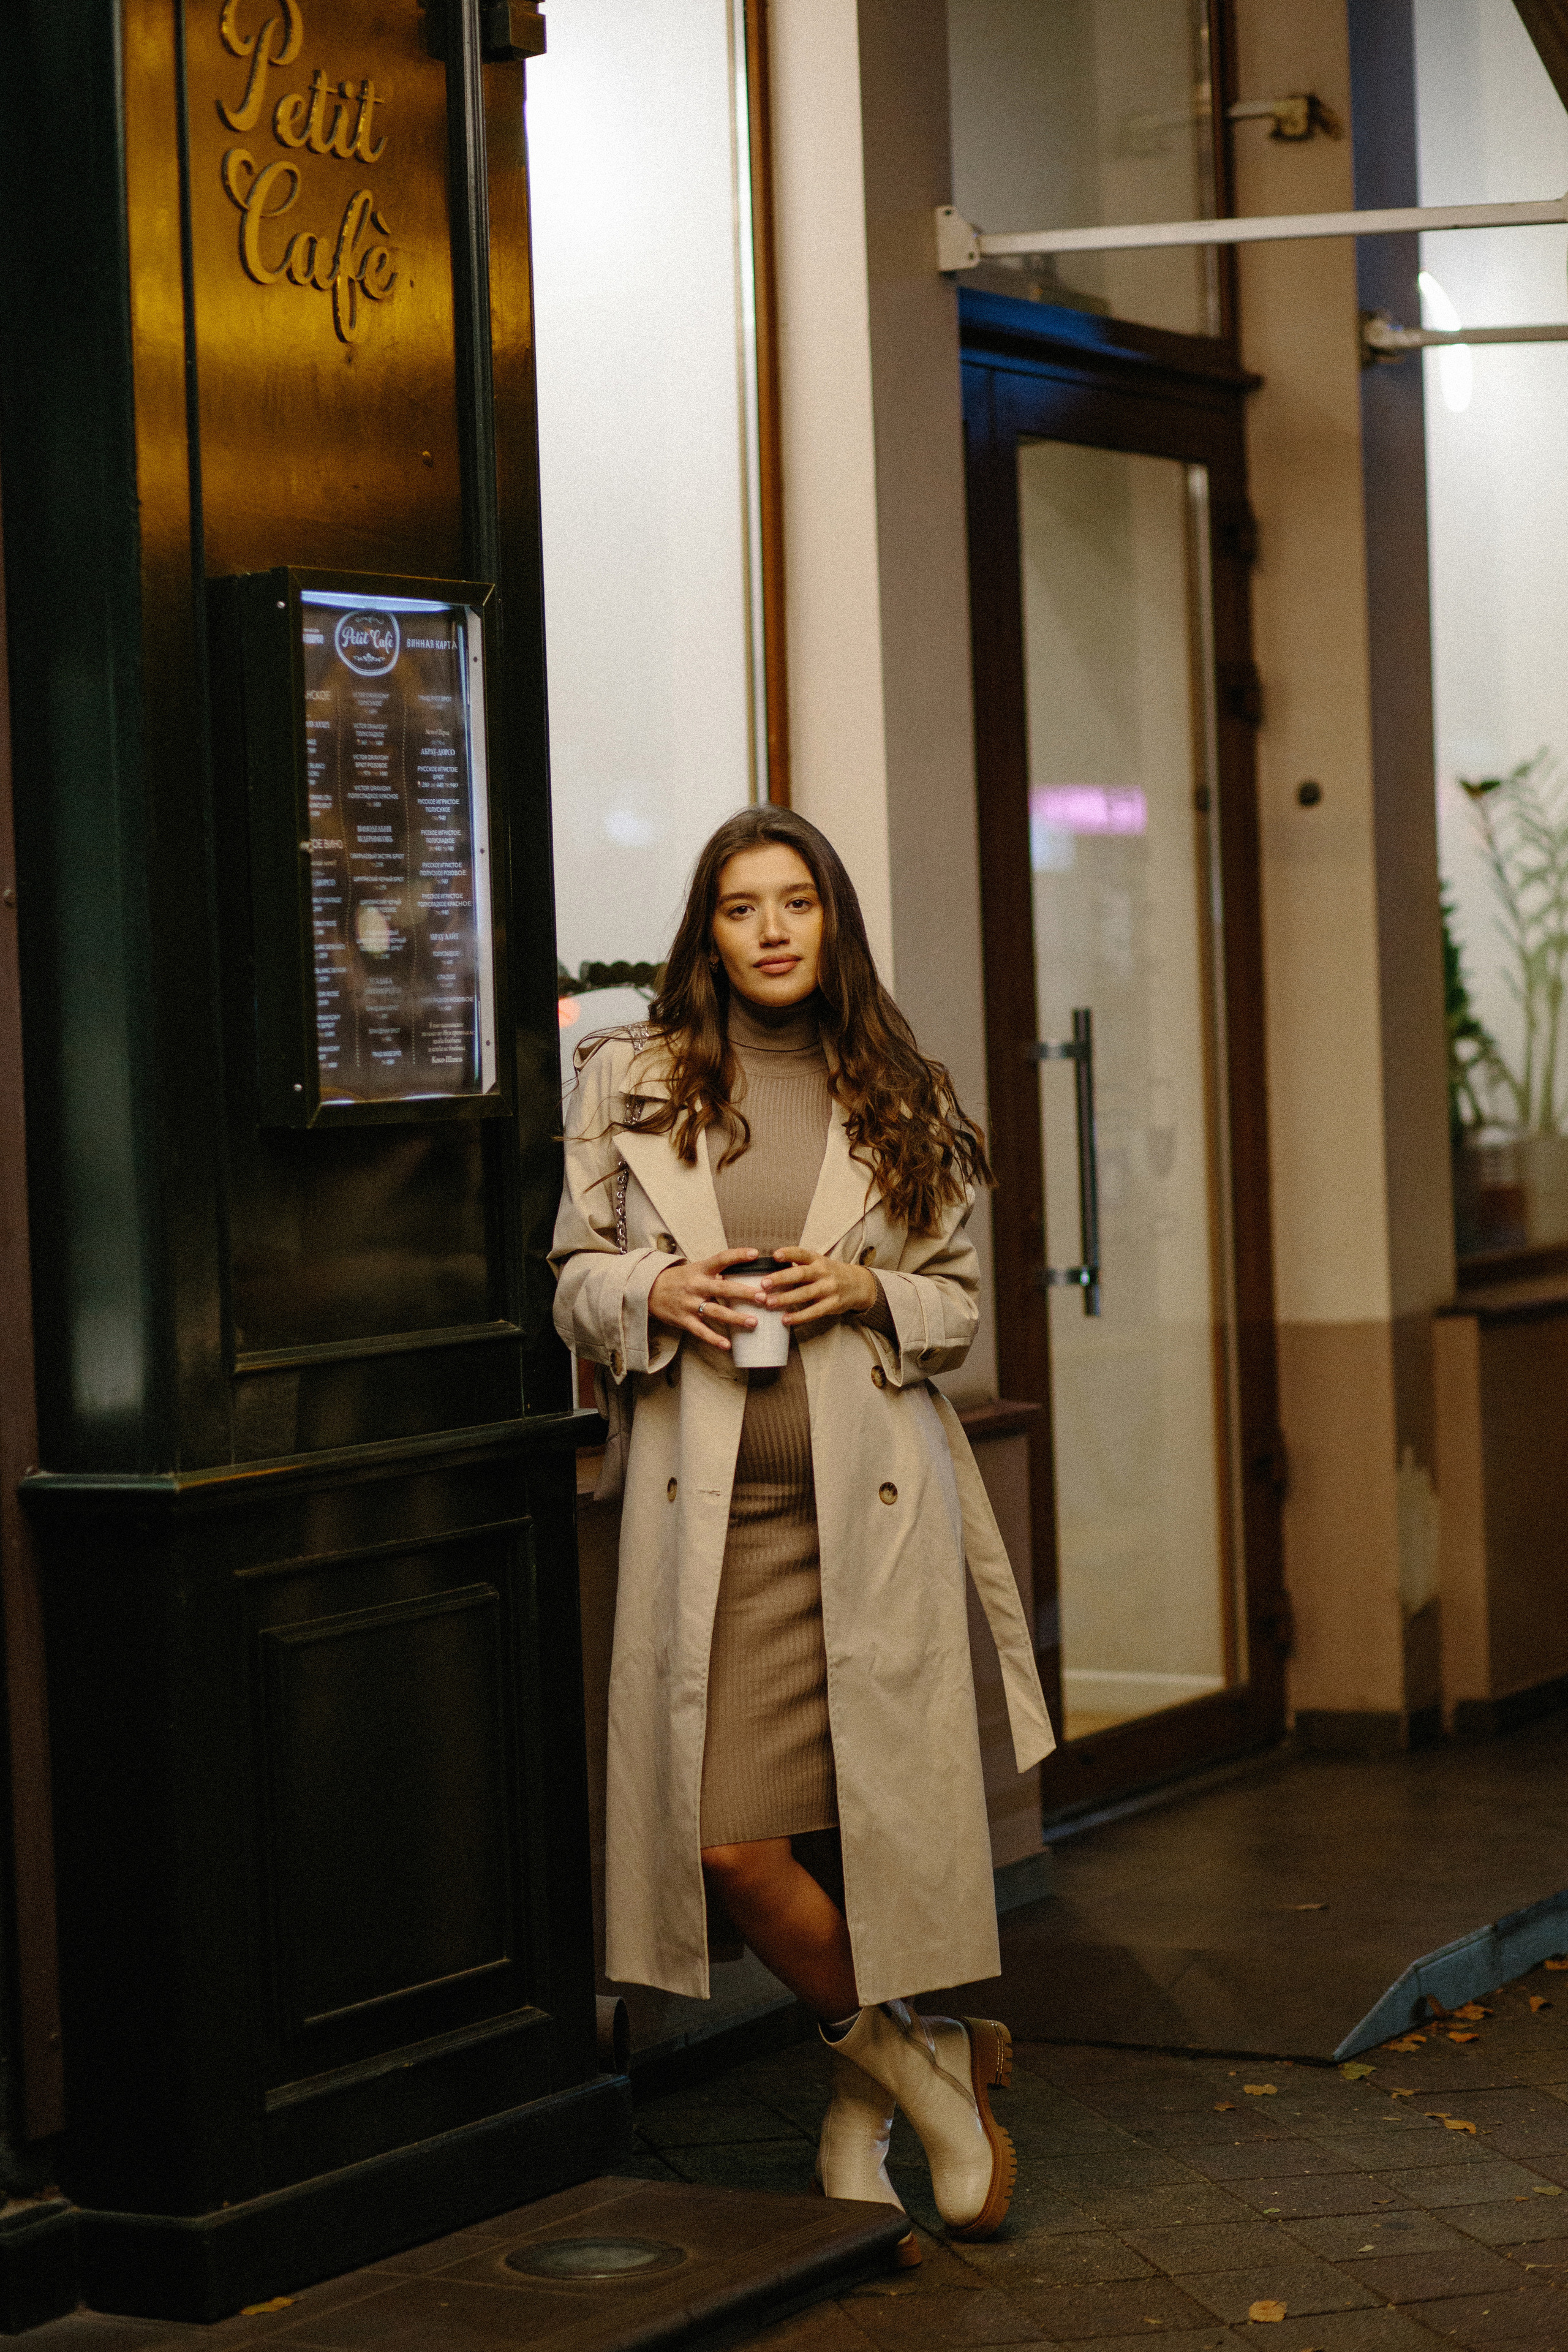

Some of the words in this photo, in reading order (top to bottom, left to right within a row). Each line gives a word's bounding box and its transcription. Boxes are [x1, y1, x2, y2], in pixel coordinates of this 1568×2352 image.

[216, 0, 387, 164] Petit
[341, 626, 369, 648] Petit
[407, 638, 434, 649] ВИННАЯ
[435, 639, 458, 650] КАРТА
